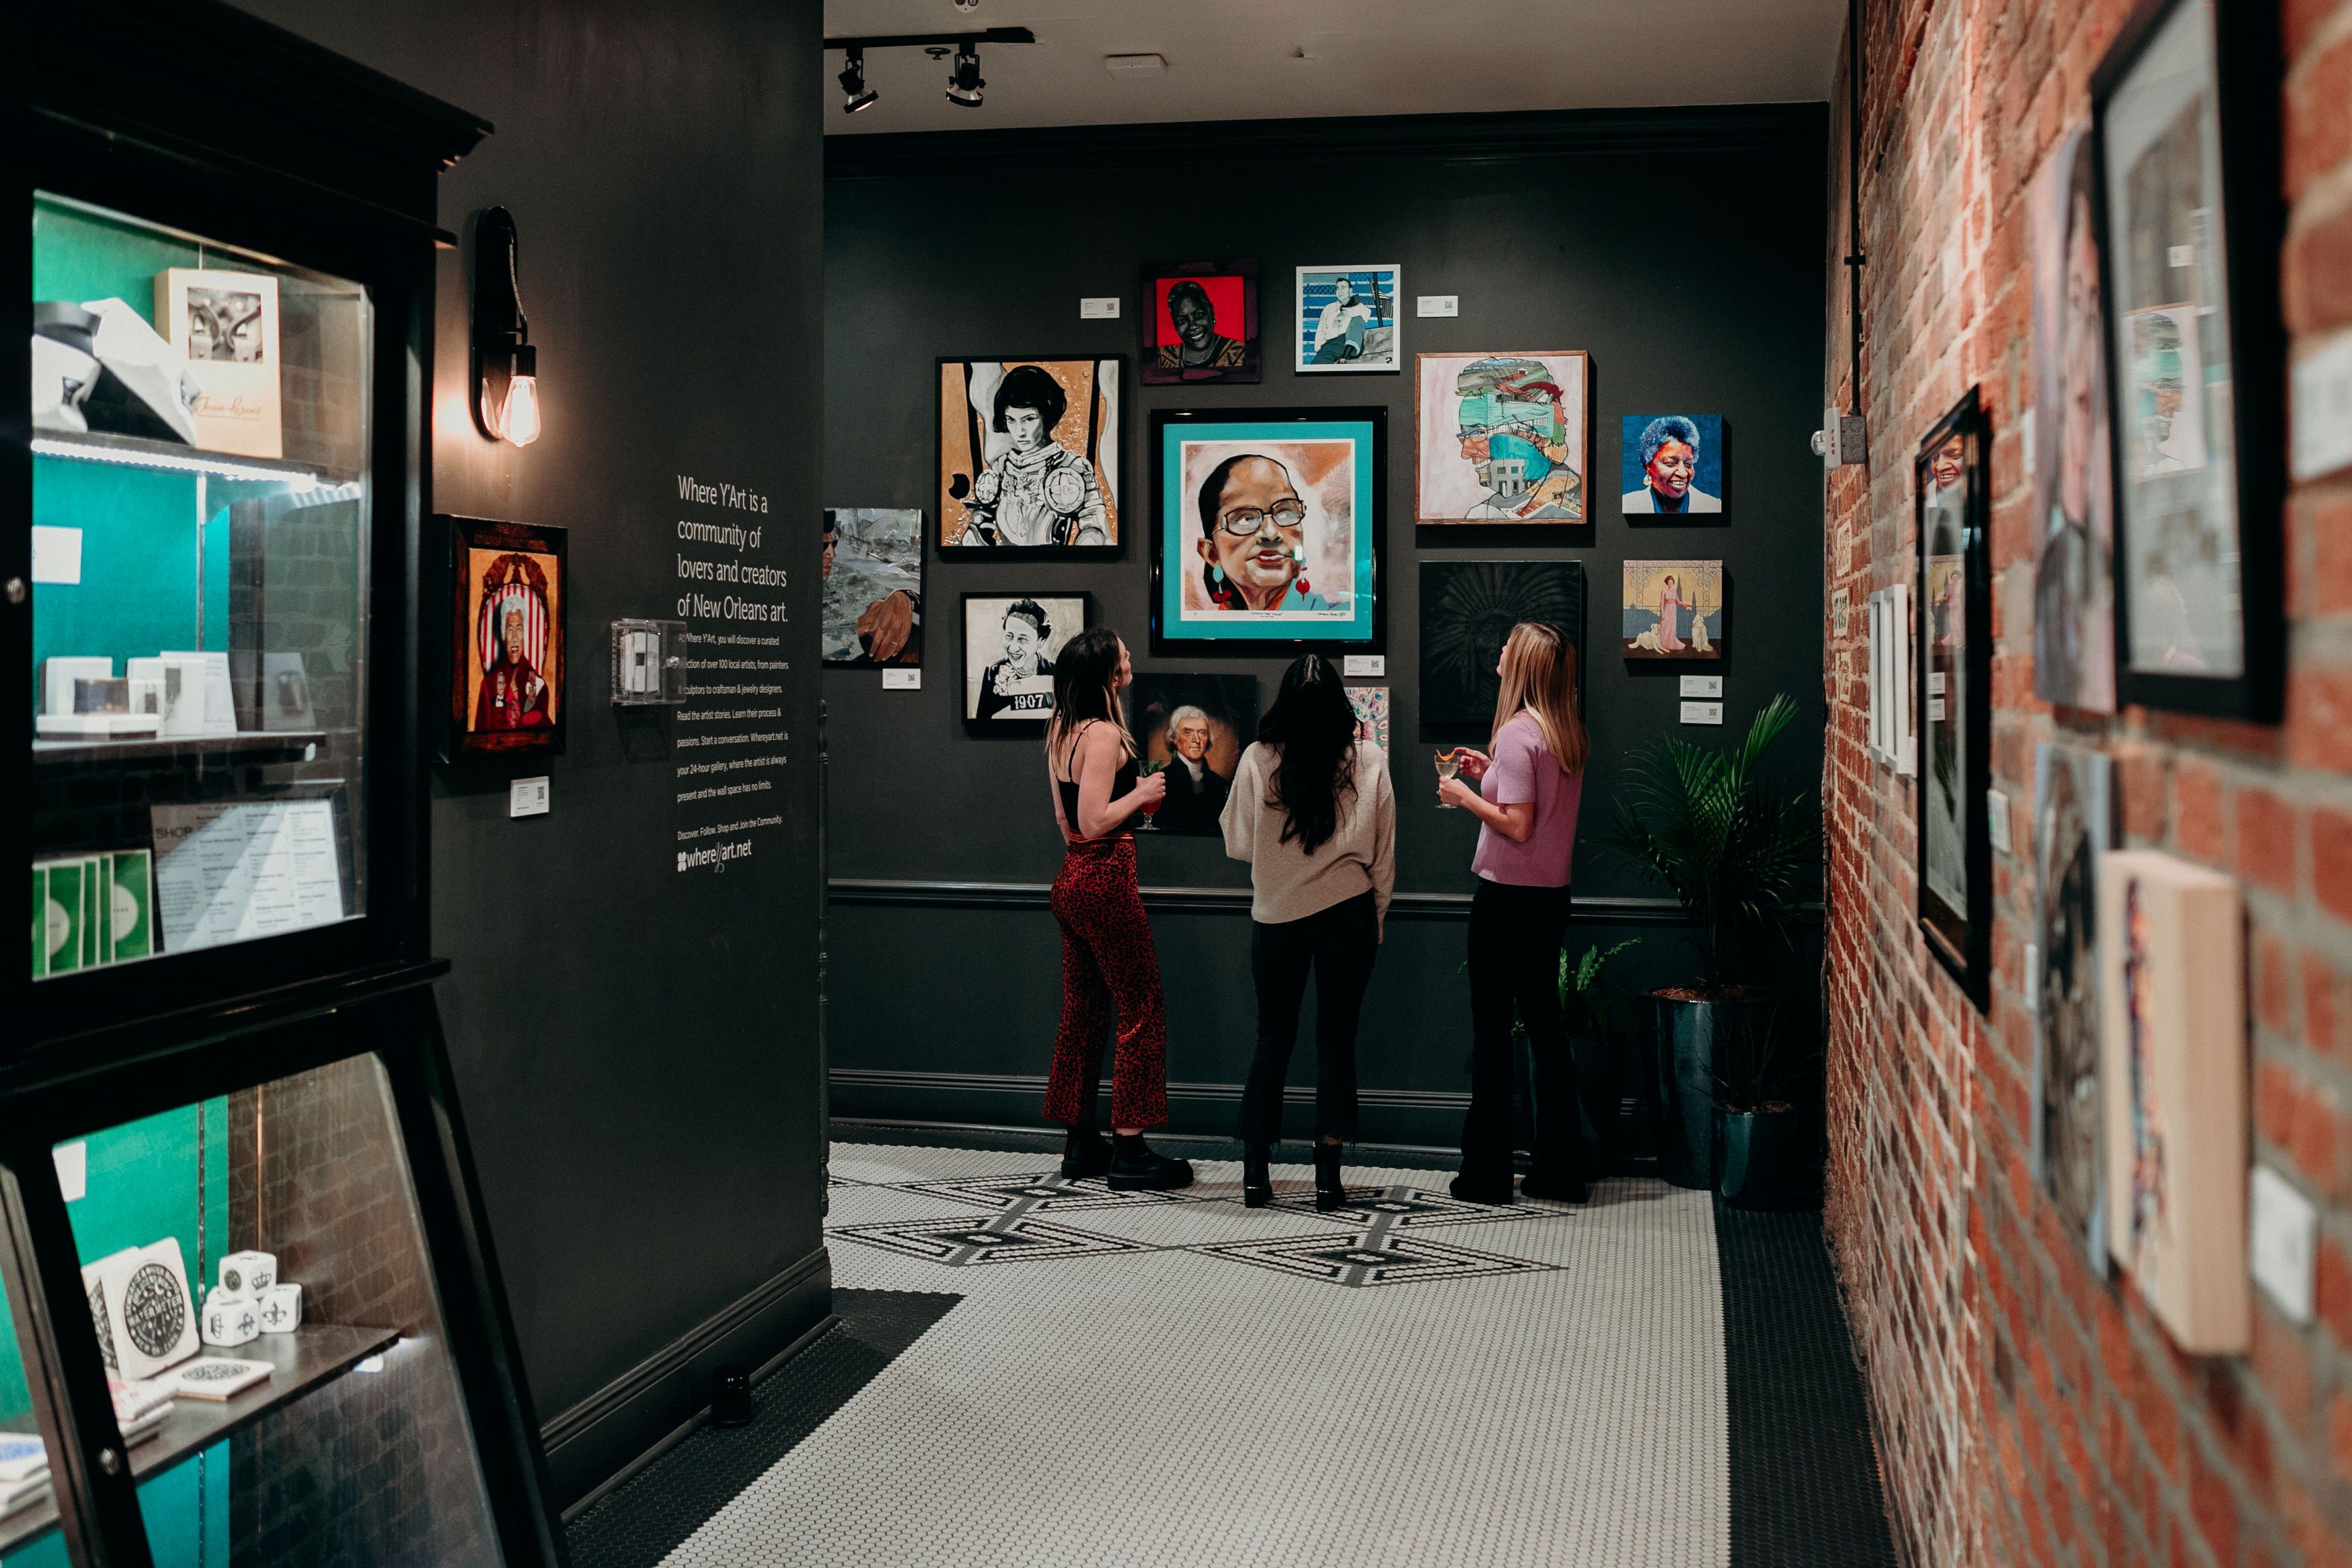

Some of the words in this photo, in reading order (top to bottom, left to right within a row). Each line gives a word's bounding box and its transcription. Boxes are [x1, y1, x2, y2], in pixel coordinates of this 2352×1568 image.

[678, 475, 717, 504] Where
[719, 482, 746, 510] Y'Art
[750, 489, 758, 512] is
[760, 496, 768, 514] a
[678, 521, 746, 552] community
[749, 527, 761, 548] of
[678, 553, 713, 580] lovers
[716, 560, 738, 582] and
[741, 565, 787, 587] creators
[678, 593, 691, 617] of
[693, 594, 721, 618] New
[724, 596, 768, 621] Orleans
[770, 602, 789, 622] art.
[703, 634, 717, 644] Y'Art,
[717, 636, 727, 645] you
[727, 634, 736, 644] will
[736, 635, 757, 645] discover
[760, 636, 779, 645] curated
[701, 659, 707, 668] of
[719, 660, 728, 669] 100
[728, 660, 740, 669] local
[741, 660, 757, 670] artists,
[757, 660, 768, 669] from
[769, 661, 789, 670] painters
[706, 685, 712, 694] to
[712, 684, 736, 694] craftsman
[737, 684, 741, 694] &
[742, 683, 759, 695] jewelry
[759, 684, 783, 694] designers.
[1015, 694, 1044, 710] 1907
[677, 711, 691, 721] Read
[691, 711, 700, 720] the
[700, 710, 713, 720] artist
[715, 709, 731, 719] stories.
[732, 709, 746, 719] Learn
[746, 708, 757, 718] their
[758, 710, 776, 719] process
[777, 708, 781, 717] &
[677, 737, 700, 749] passions.
[701, 736, 713, 745] Start
[718, 734, 750, 743] conversation.
[784, 732, 789, 740] is
[677, 766, 690, 777] your
[690, 763, 710, 774] 24-hour
[711, 761, 728, 774] gallery,
[729, 760, 743, 769] where
[753, 757, 766, 766] artist
[766, 755, 770, 765] is
[771, 755, 787, 766] always
[677, 791, 697, 804] present
[698, 788, 708, 798] and
[717, 785, 727, 795] wall
[728, 786, 742, 796] space
[742, 783, 751, 792] has
[758, 780, 772, 790] limits.
[155, 826, 192, 839] SHOP
[677, 830, 699, 840] Discover.
[700, 826, 717, 836] Follow.
[717, 824, 729, 834] Shop
[729, 821, 738, 831] and
[740, 820, 749, 830] Join
[757, 815, 783, 826] Community.
[155, 1294, 183, 1315] METER
